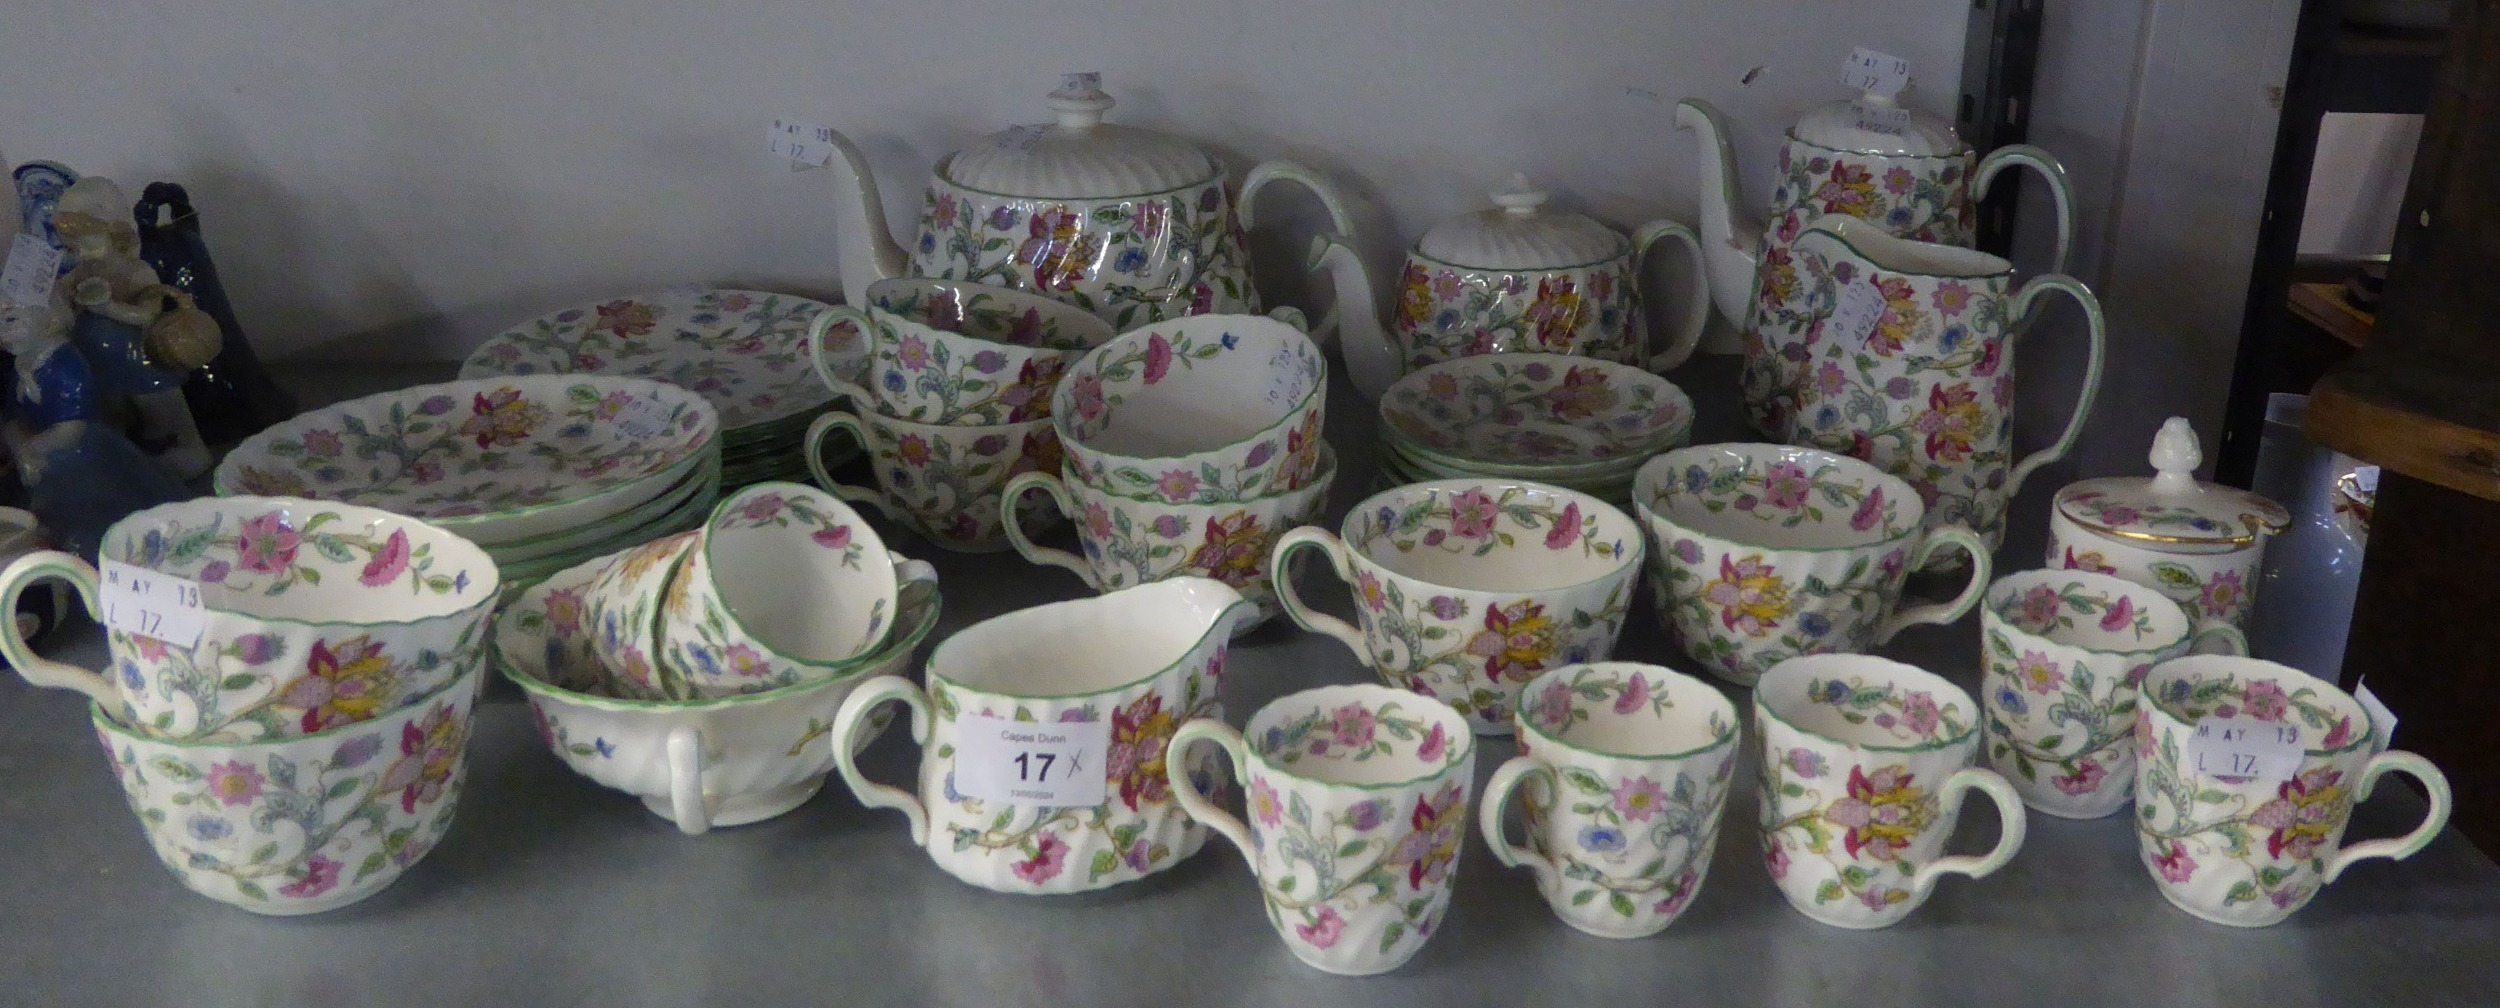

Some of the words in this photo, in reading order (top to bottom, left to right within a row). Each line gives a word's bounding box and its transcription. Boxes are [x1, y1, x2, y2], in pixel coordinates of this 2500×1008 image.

[109, 602, 118, 623] L
[1001, 729, 1035, 744] Capes
[1038, 732, 1067, 745] Dunn
[1014, 751, 1057, 783] 17
[2198, 752, 2207, 771] L
